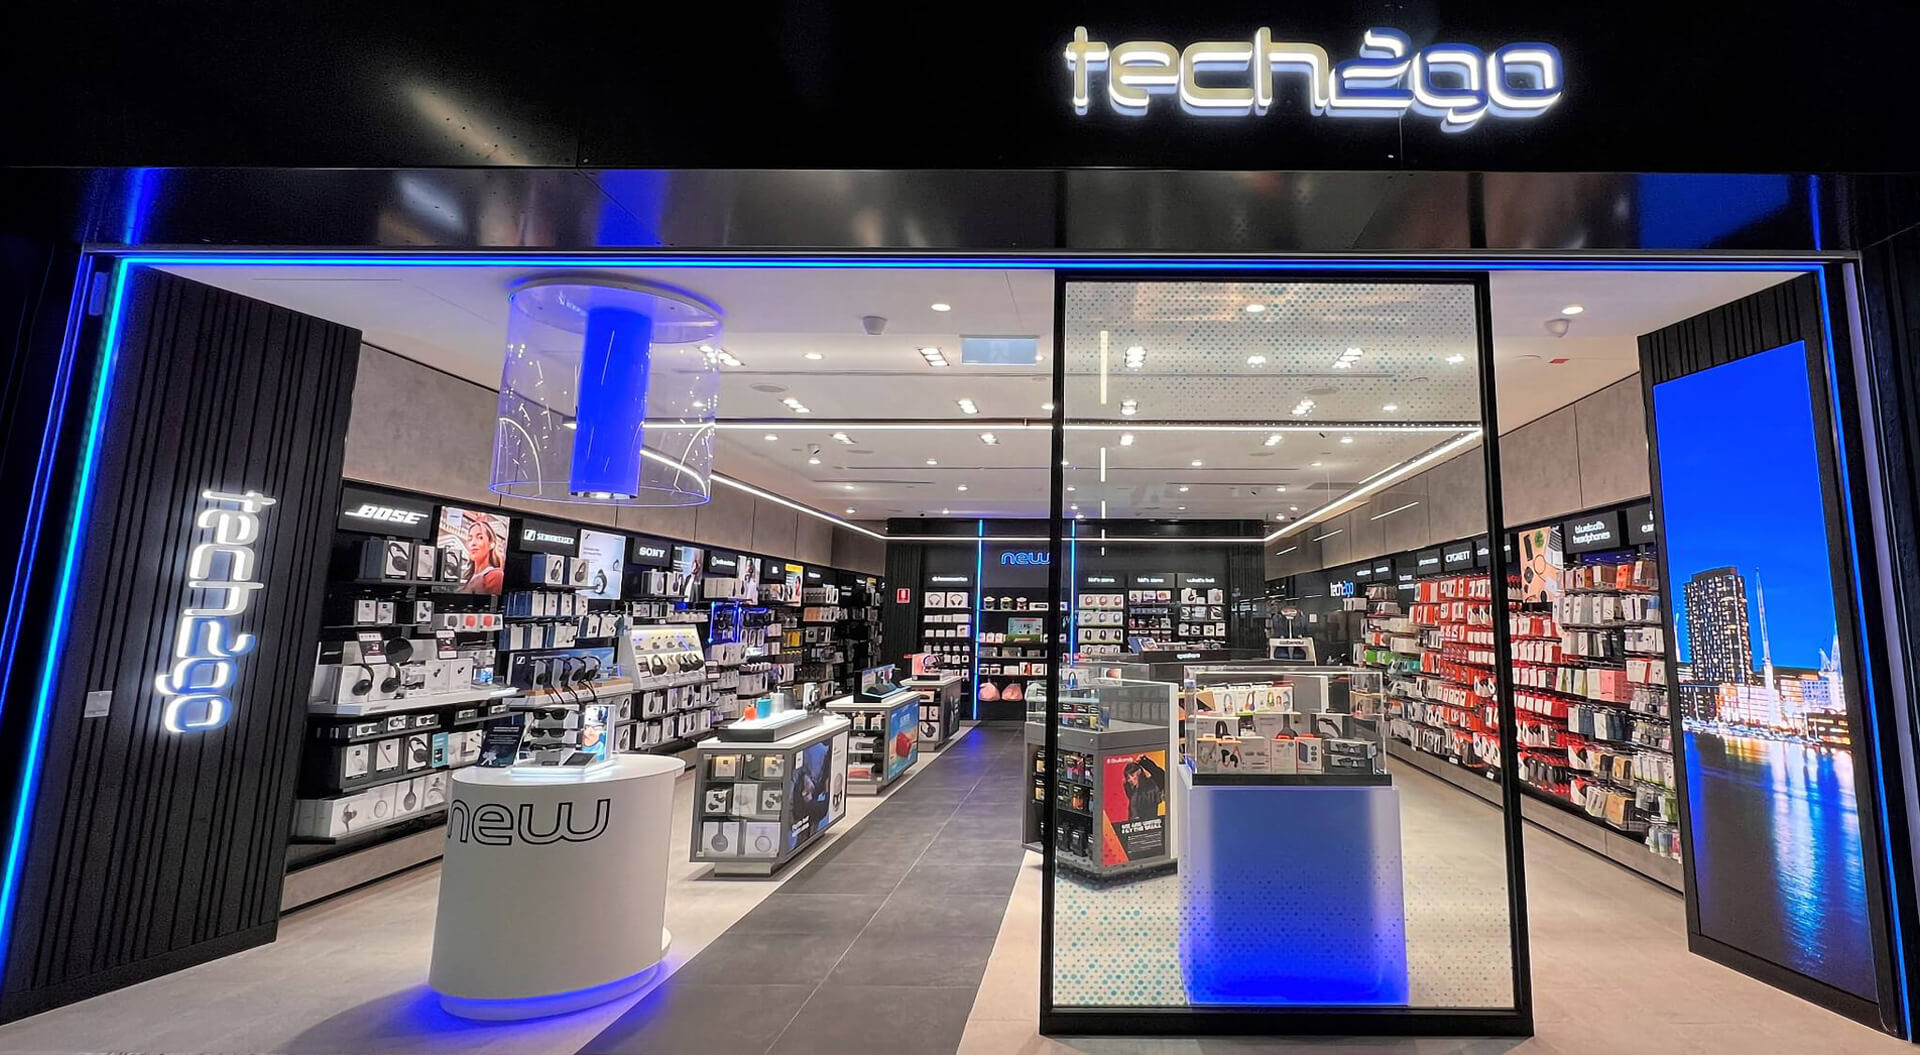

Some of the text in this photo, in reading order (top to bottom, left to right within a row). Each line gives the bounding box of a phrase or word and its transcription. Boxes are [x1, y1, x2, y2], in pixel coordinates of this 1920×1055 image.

[1065, 26, 1564, 131] tech2go
[344, 504, 429, 525] BOSE
[639, 546, 666, 558] SONY
[1001, 552, 1050, 564] new
[155, 490, 277, 733] tech2go
[448, 799, 611, 846] new
